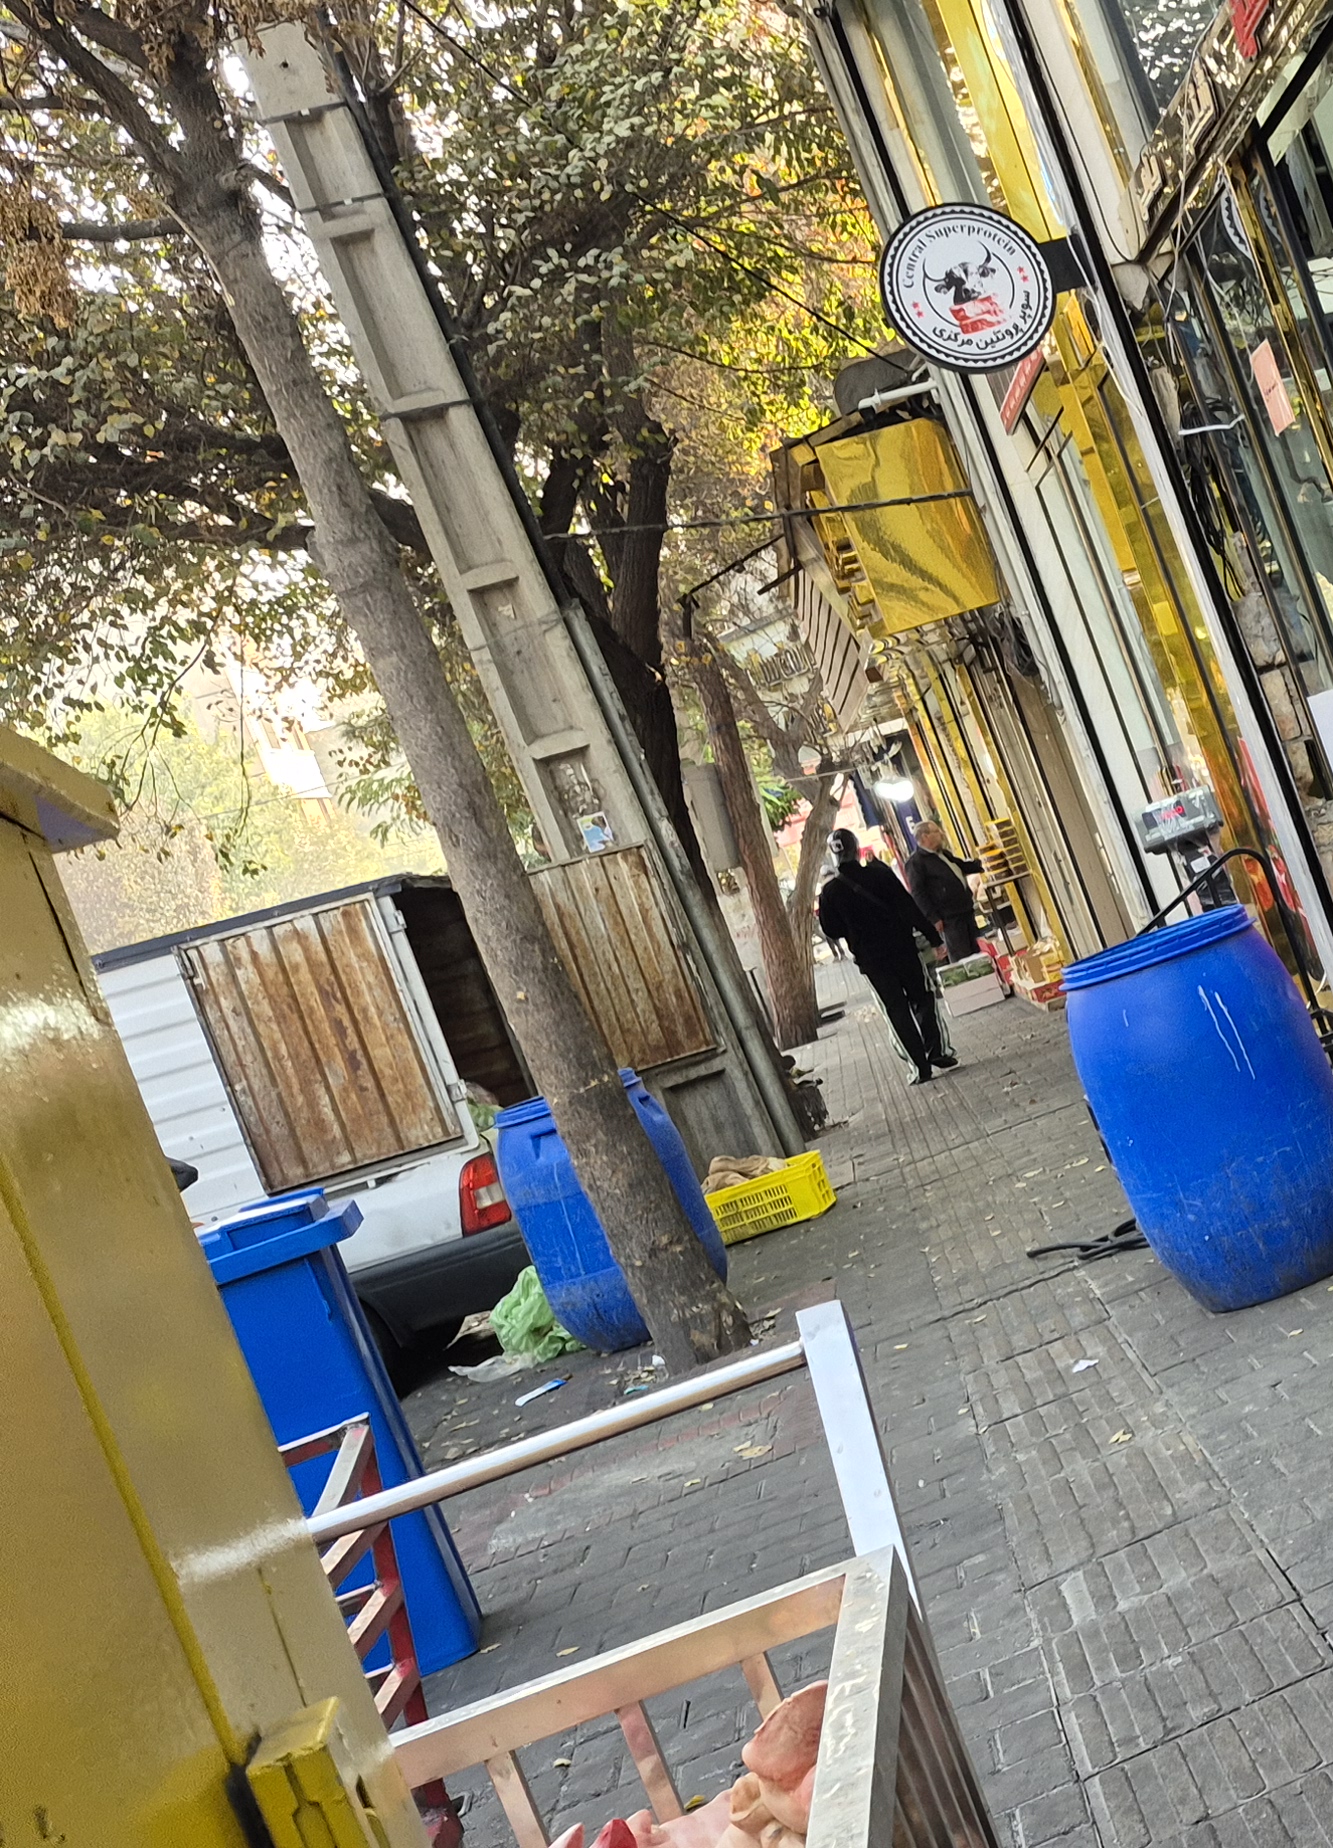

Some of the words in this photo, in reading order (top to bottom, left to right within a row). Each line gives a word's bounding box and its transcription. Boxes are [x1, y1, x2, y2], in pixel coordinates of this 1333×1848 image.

[903, 238, 927, 289] Central
[925, 224, 1016, 256] Superprotein
[1019, 290, 1032, 324] سوپر
[932, 325, 974, 348] مرکزی
[975, 323, 1025, 351] پروتئین
